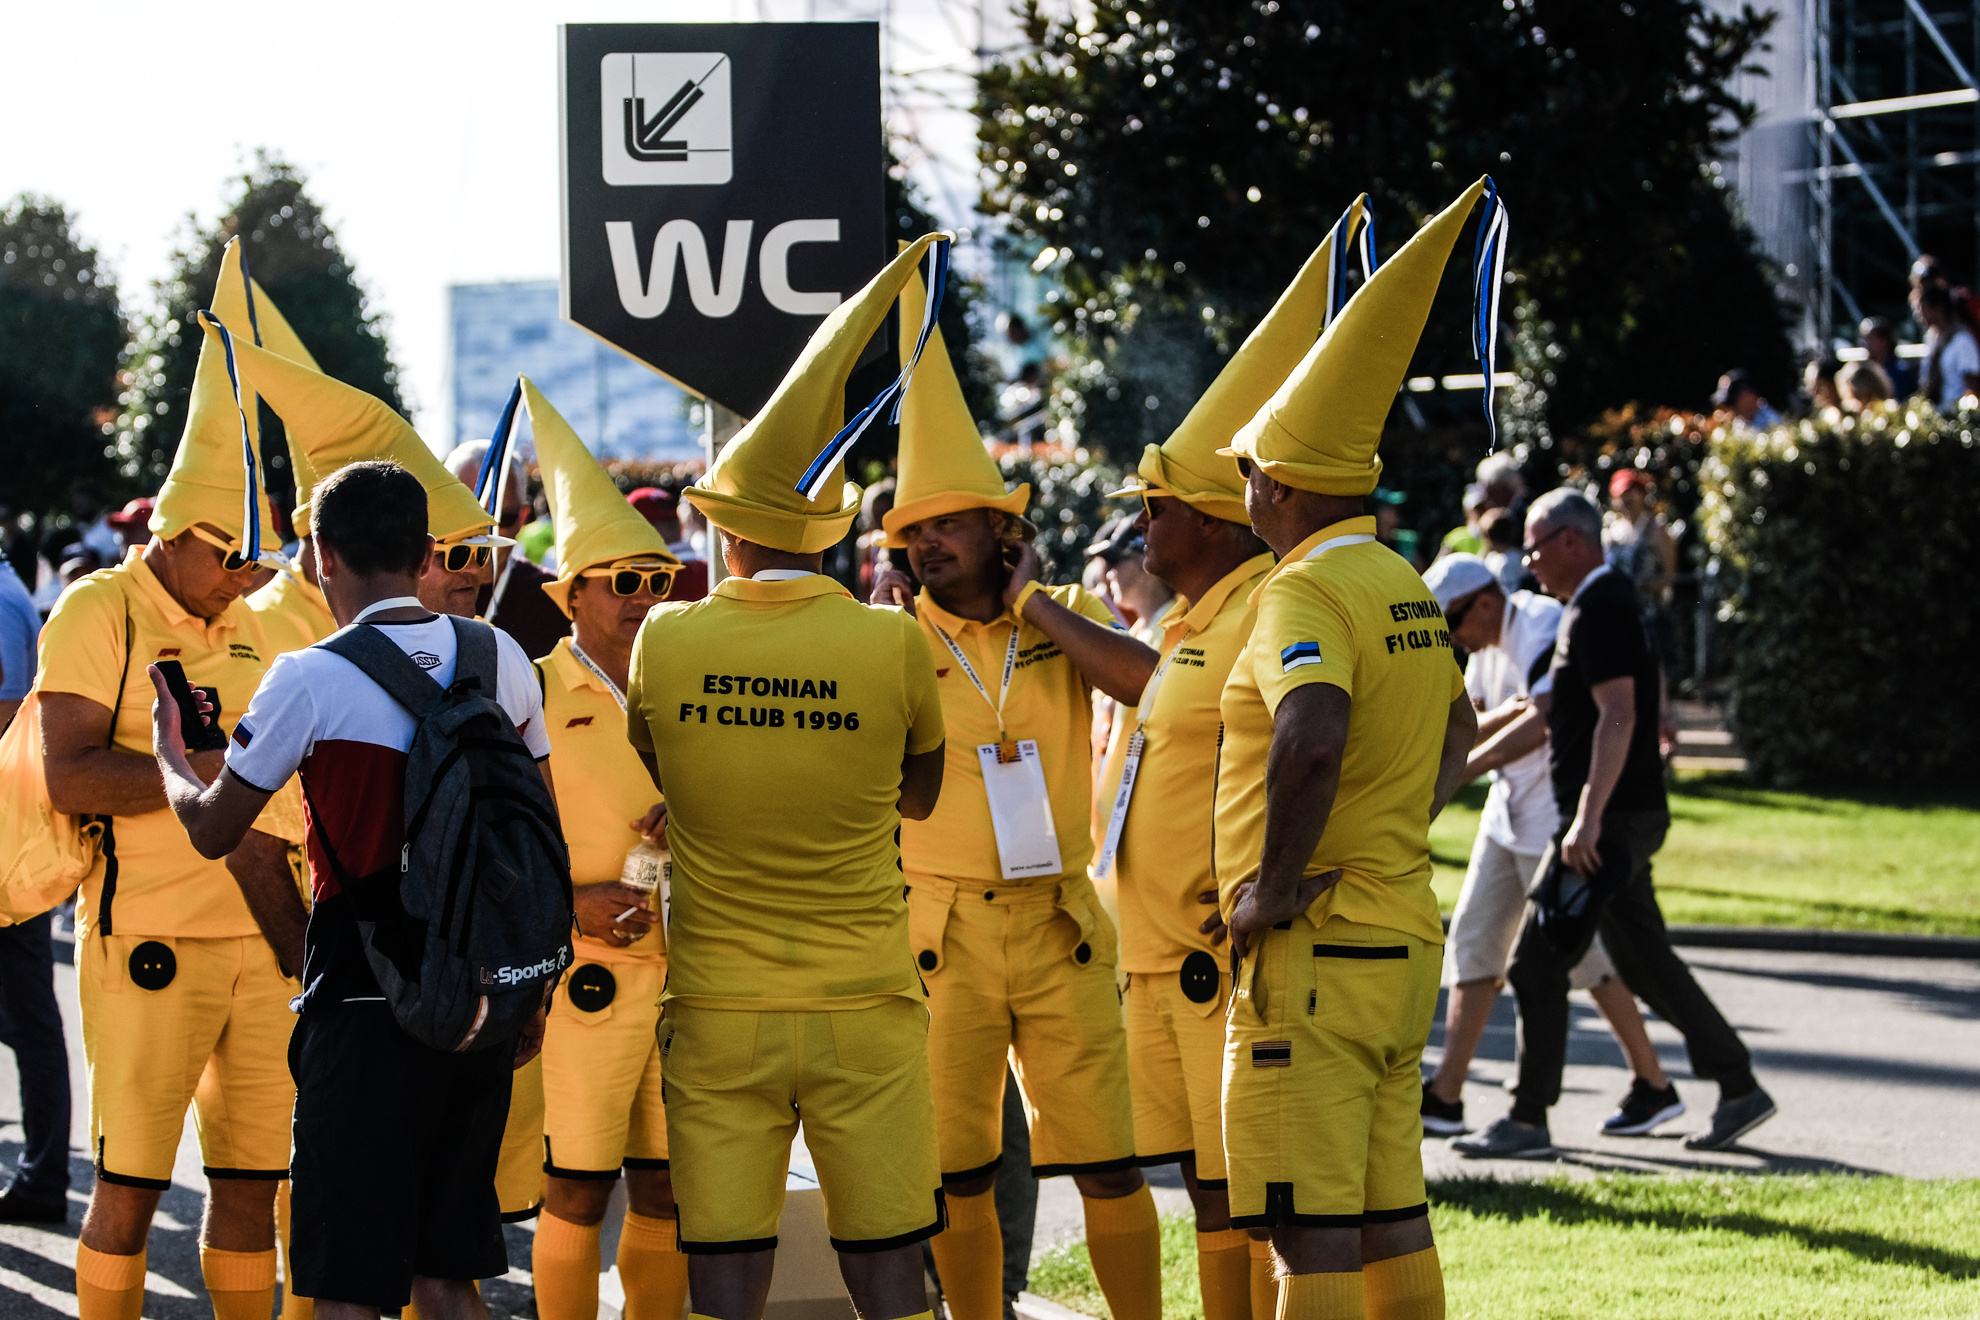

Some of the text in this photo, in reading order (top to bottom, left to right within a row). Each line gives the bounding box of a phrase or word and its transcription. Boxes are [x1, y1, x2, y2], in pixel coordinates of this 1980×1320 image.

[605, 218, 842, 319] WC
[1385, 633, 1404, 654] F1
[1407, 630, 1432, 649] CLUB
[703, 674, 837, 699] ESTONIAN
[679, 703, 860, 731] F1 CLUB 1996
